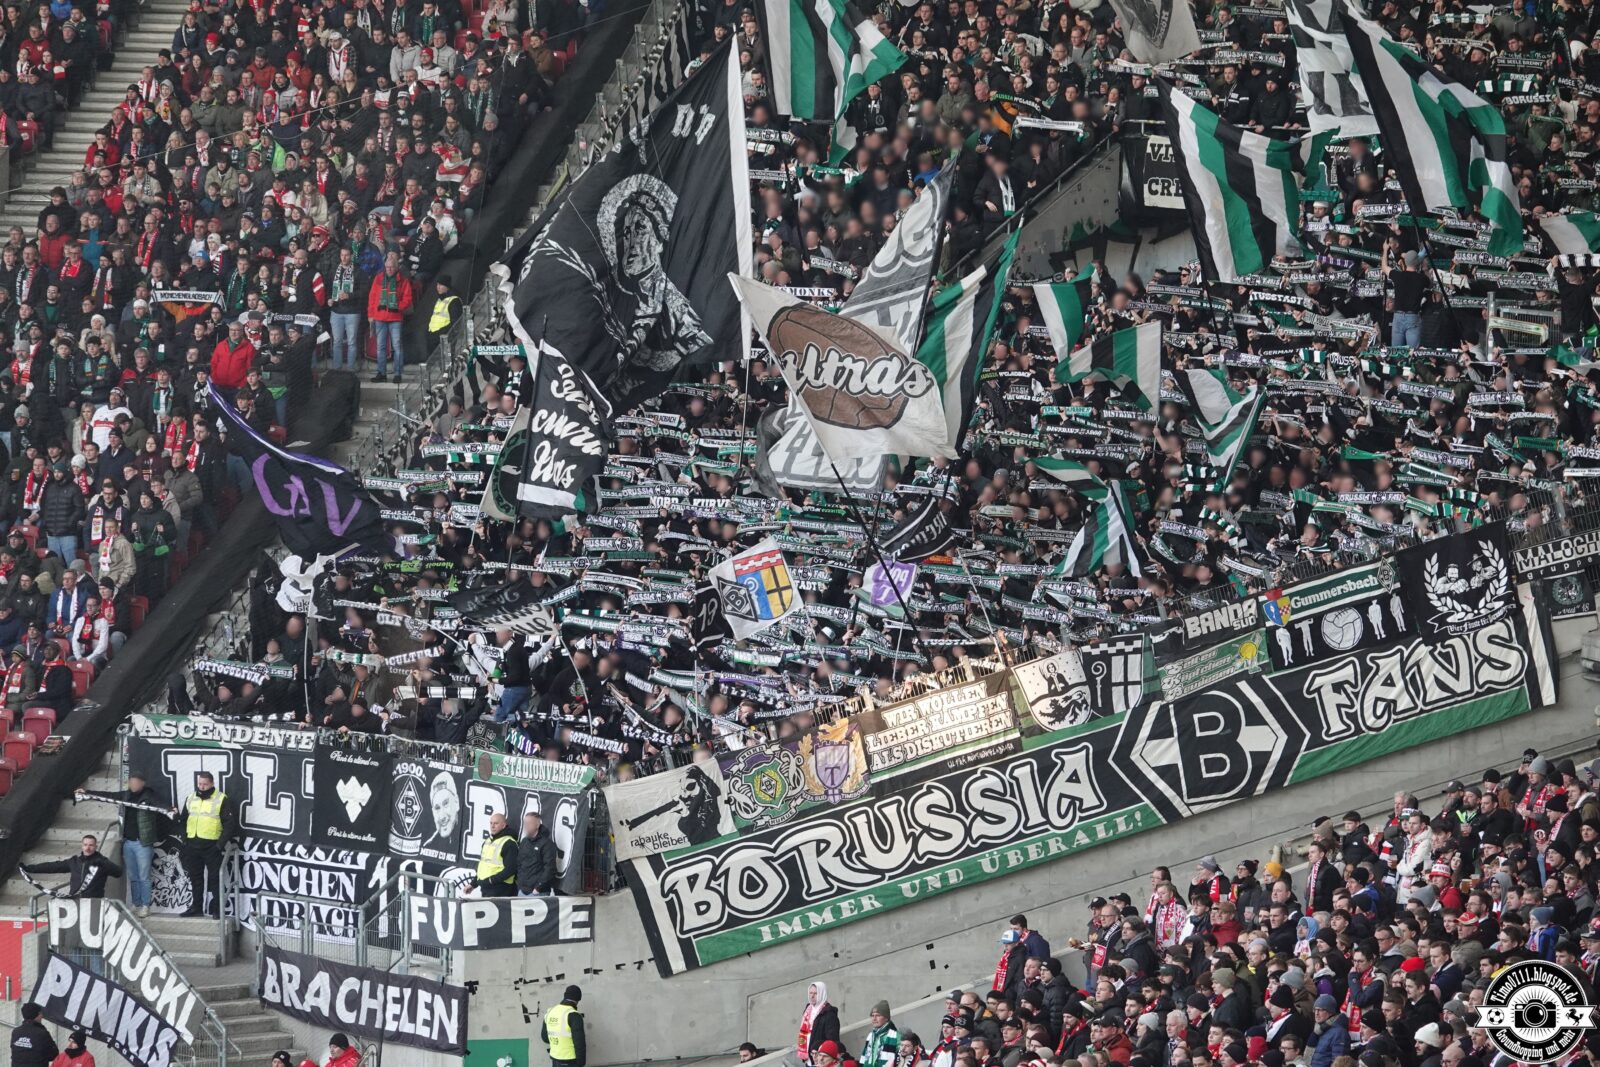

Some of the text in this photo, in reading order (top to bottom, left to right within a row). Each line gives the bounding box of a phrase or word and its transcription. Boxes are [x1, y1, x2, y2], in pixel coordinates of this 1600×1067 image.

[1515, 530, 1600, 574] MALOCH
[1526, 556, 1594, 580] gruppe
[1290, 574, 1379, 609] Gummersbach
[1185, 598, 1258, 639] BANDA
[1233, 615, 1257, 630] SUD
[1304, 616, 1528, 742] FANS
[881, 681, 987, 728] WIR WOLLEN
[139, 718, 315, 750] ASCENDENTE
[864, 717, 930, 753] LIEBER
[870, 709, 1015, 774] ALS DISKUTIEREN
[502, 755, 588, 785] STADIONVERBOT
[630, 831, 670, 848] rabauke
[663, 743, 1105, 934] BORUSSIA
[757, 810, 1144, 944] IMMER UND ÜBERALL!
[409, 894, 593, 947] FUPPE
[48, 898, 197, 1046] PUMUCKL
[33, 955, 178, 1067] PINKIS
[261, 956, 459, 1045] BRACHELEN
